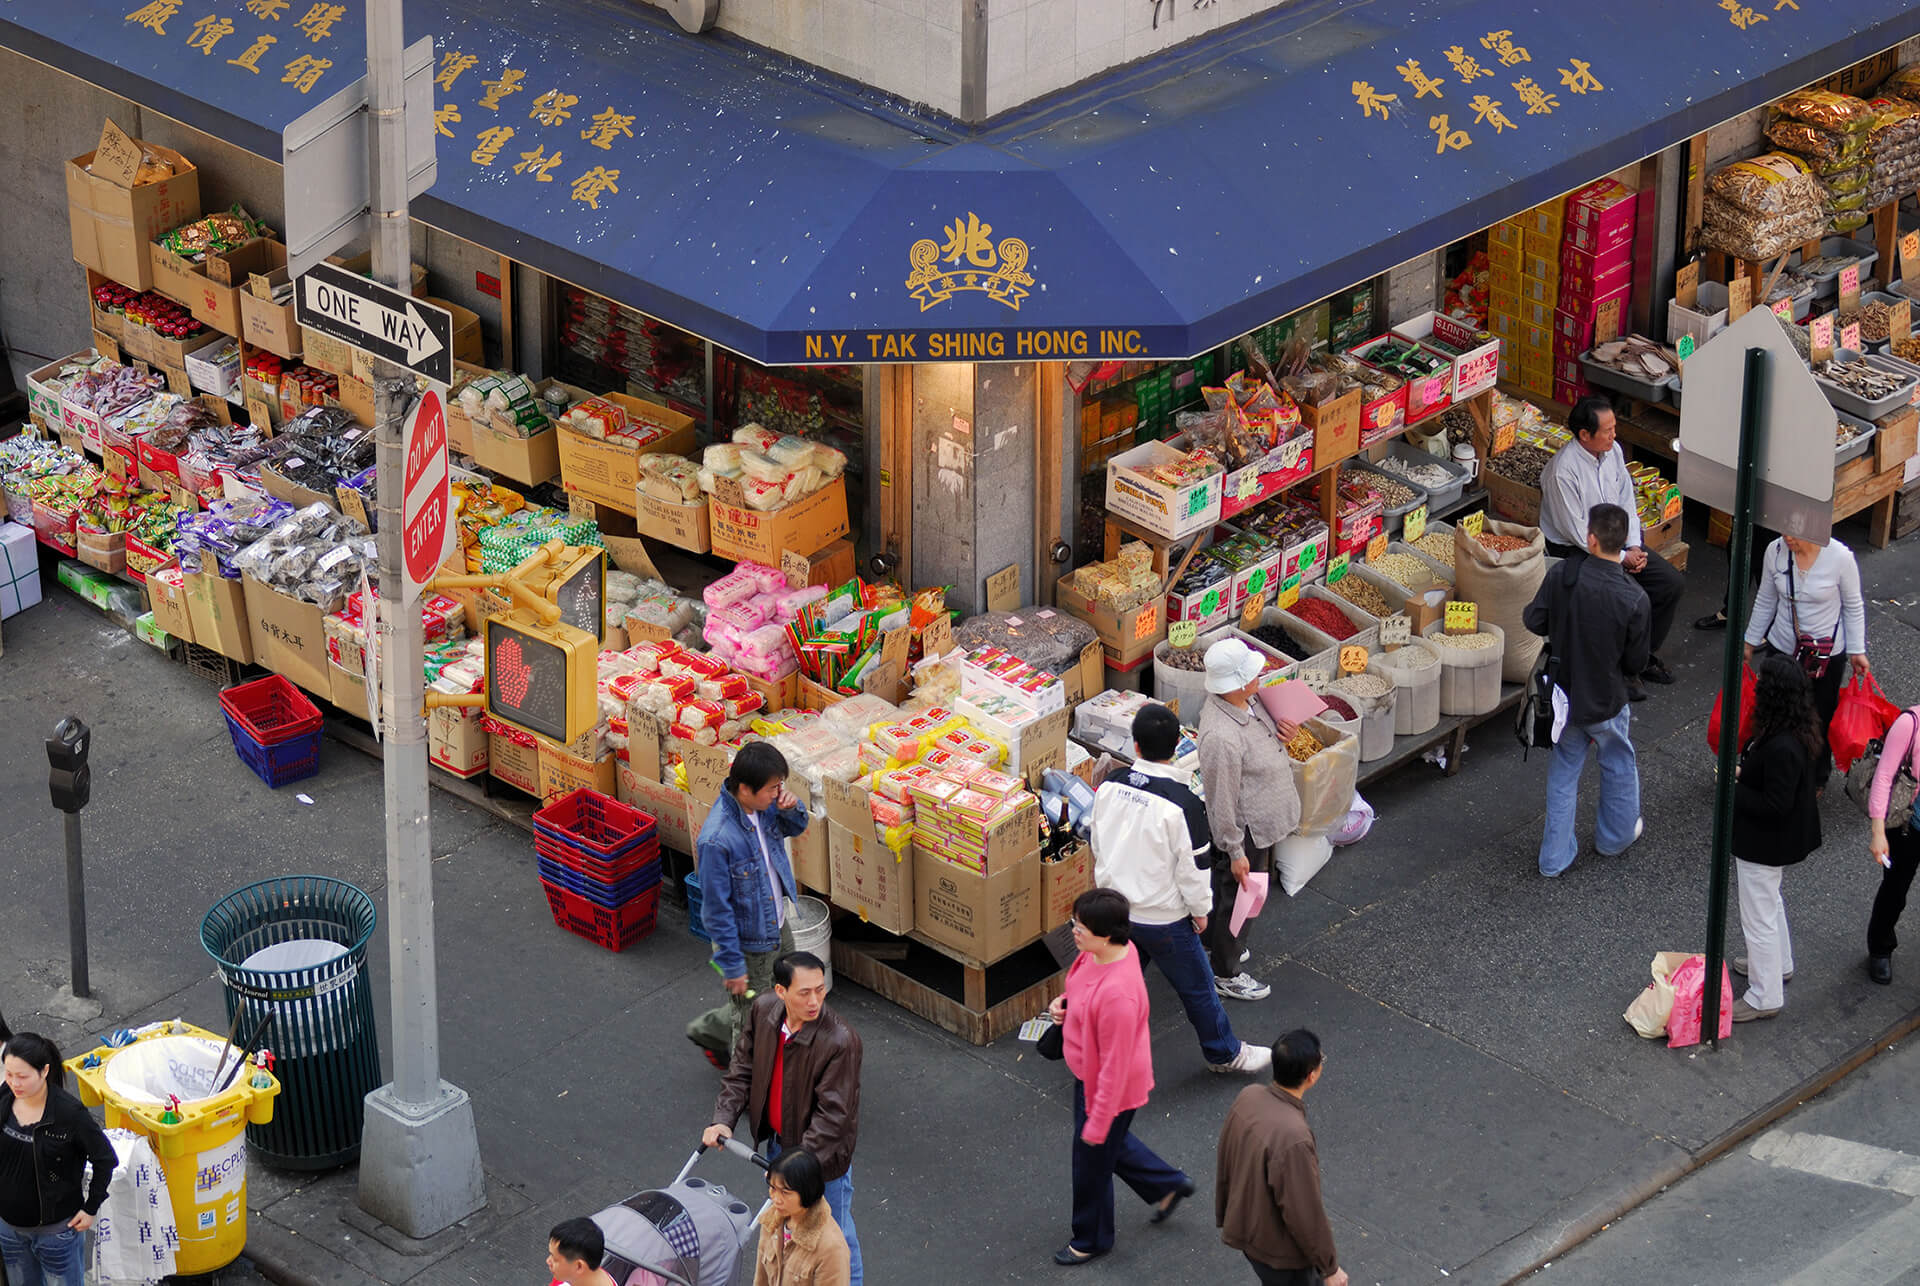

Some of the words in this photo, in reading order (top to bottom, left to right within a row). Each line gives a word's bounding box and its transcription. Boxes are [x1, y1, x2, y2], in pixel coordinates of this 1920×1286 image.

[317, 285, 361, 326] ONE
[381, 310, 426, 351] WAY
[1435, 318, 1473, 340] ALNUTS
[805, 334, 854, 359] N.Y.
[867, 333, 917, 358] TAK
[928, 332, 1005, 358] SHING
[1017, 330, 1088, 356] HONG
[1100, 329, 1149, 355] INC.
[409, 441, 421, 481] DO
[424, 411, 441, 459] NOT
[411, 497, 442, 559] ENTER
[244, 987, 269, 998] Journal
[222, 1144, 248, 1172] CPLD
